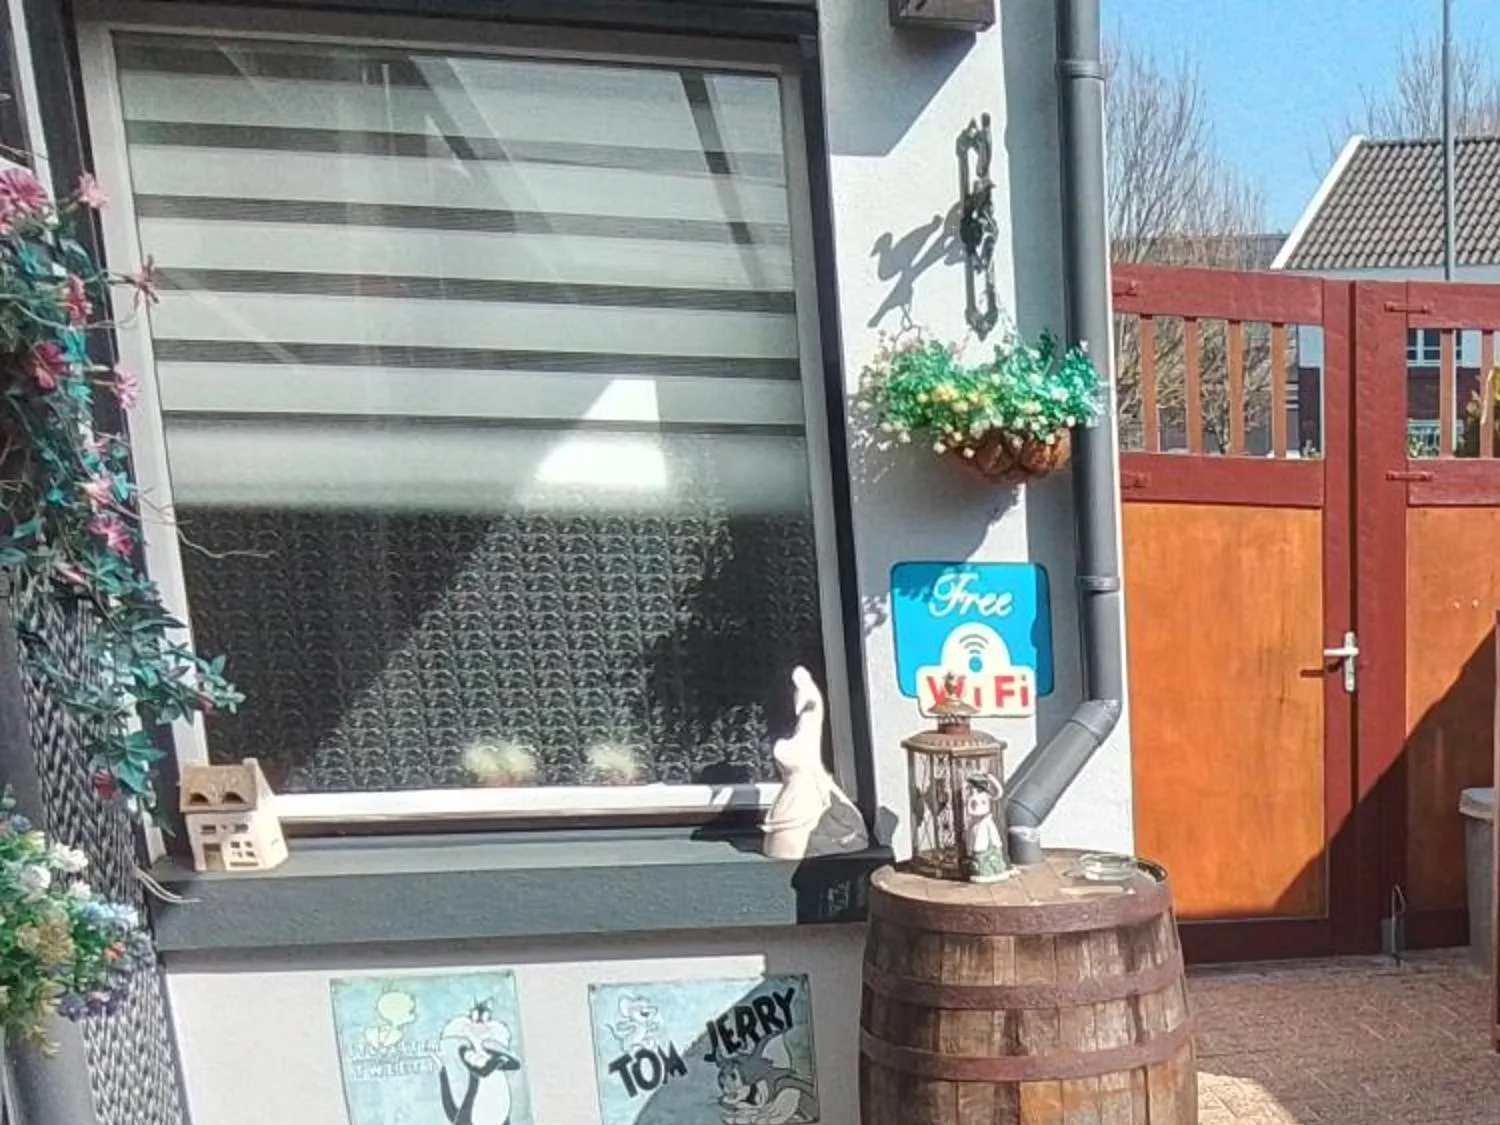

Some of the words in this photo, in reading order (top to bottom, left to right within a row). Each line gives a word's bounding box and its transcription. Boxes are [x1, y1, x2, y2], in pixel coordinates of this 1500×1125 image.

[928, 572, 1013, 618] Free
[608, 1040, 689, 1099] TOM
[704, 987, 796, 1063] JERRY
